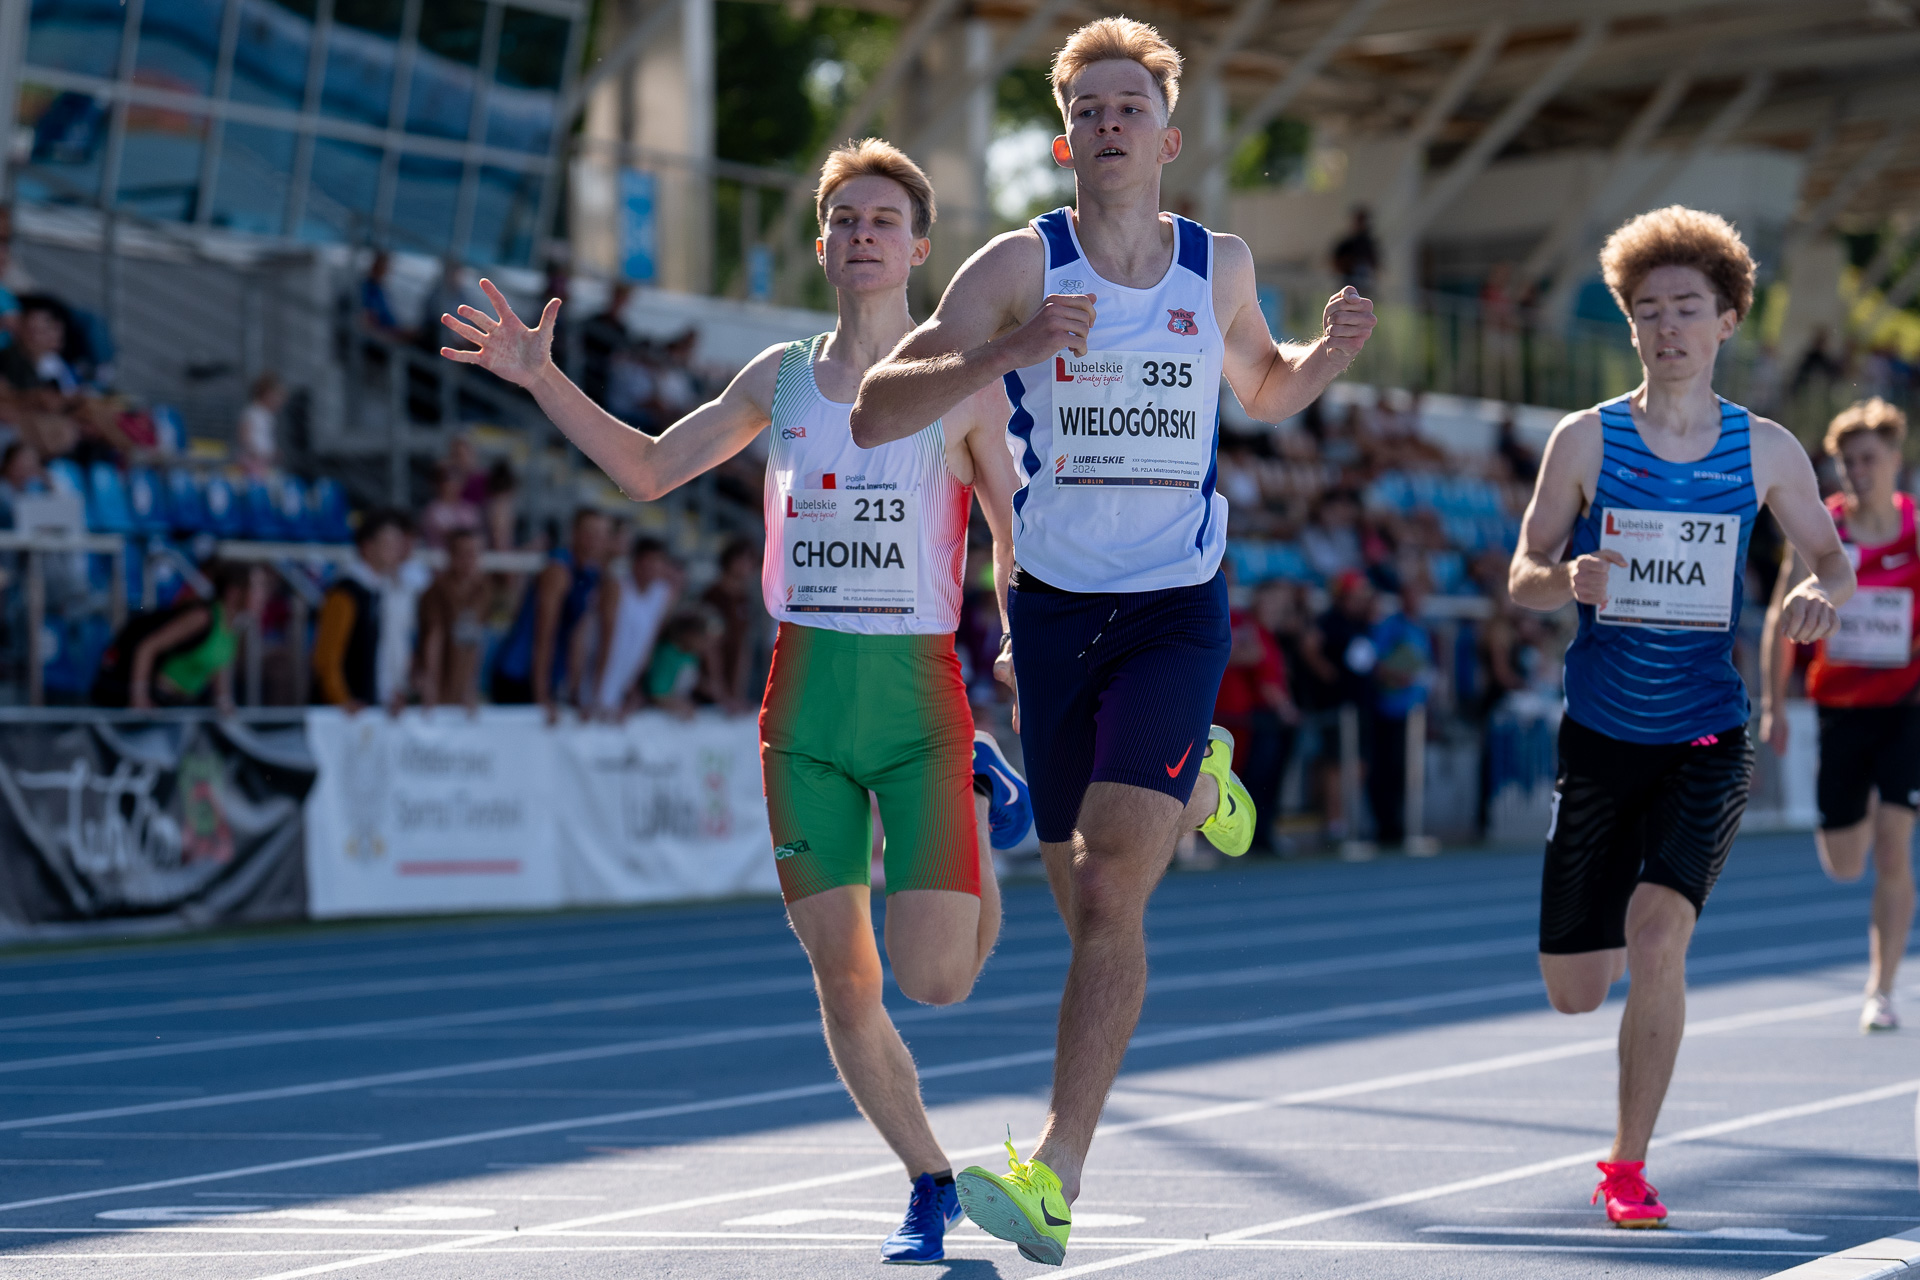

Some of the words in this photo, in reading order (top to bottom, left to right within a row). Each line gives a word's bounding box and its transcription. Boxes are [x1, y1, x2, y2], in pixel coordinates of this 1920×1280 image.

[1142, 360, 1192, 388] 335
[1059, 402, 1196, 439] WIELOGÓRSKI
[1072, 465, 1096, 474] 2024
[1073, 456, 1125, 464] LUBELSKIE
[1149, 478, 1190, 487] 5-7.07.2024
[854, 498, 905, 522] 213
[1680, 521, 1726, 544] 371
[792, 540, 905, 569] CHOINA
[1630, 558, 1706, 586] MIKA
[797, 585, 838, 593] LUBELSKIE
[1615, 597, 1661, 607] LUBELSKIE
